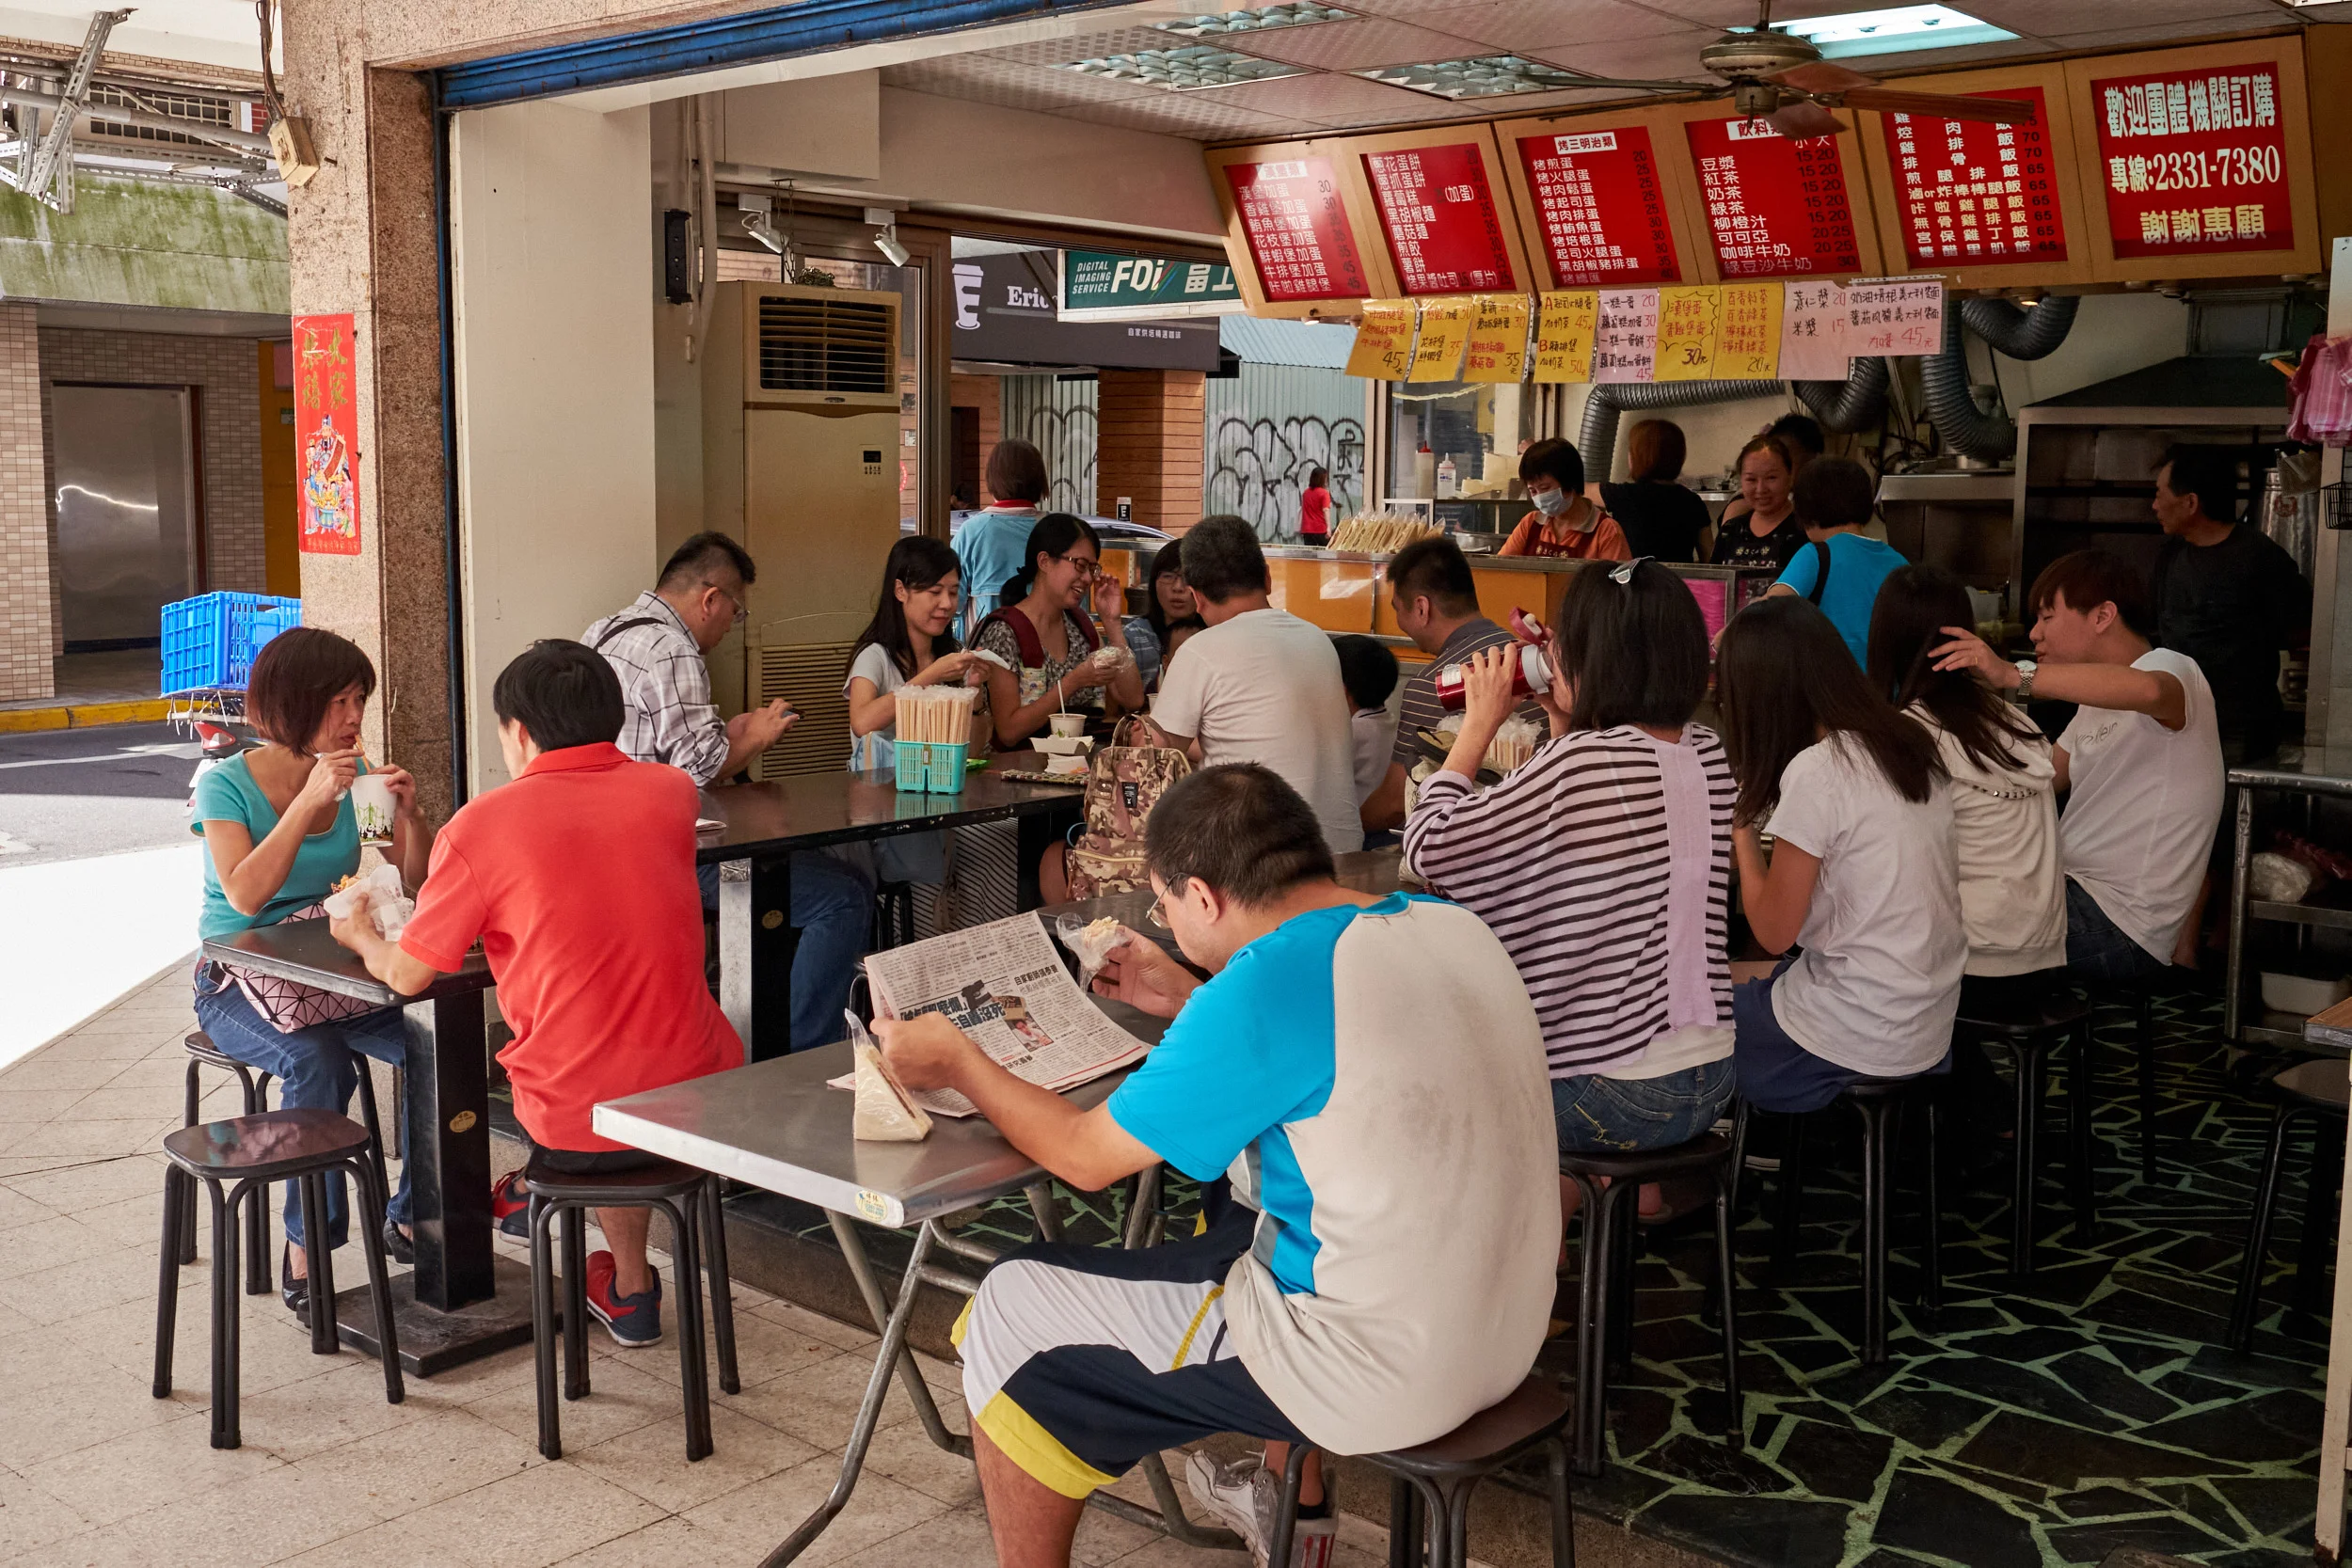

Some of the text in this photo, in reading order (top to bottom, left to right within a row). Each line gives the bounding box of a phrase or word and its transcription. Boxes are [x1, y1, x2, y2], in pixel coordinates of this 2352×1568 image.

[2105, 72, 2275, 137] 歡迎團體機關訂購
[1558, 135, 1614, 150] 烤三明治類
[2023, 132, 2040, 142] 70
[1700, 148, 1836, 172] 豆漿 15 20
[2025, 148, 2042, 158] 70
[1533, 156, 1575, 171] 烤煎蛋
[2026, 163, 2045, 174] 65
[2108, 145, 2280, 194] 專線:2331-7380
[1535, 168, 1591, 183] 烤火腿蛋
[1703, 163, 1838, 186] 紅茶 15 20
[1238, 180, 1331, 200] 漢堡加蛋 30
[1707, 179, 1841, 201] 奶茶 15 20
[2029, 180, 2047, 190] 65
[1244, 197, 1336, 216] 香雞堡加蛋 30
[1542, 196, 1597, 210] 烤起司蛋
[1709, 195, 1845, 216] 綠茶 15 20
[2032, 195, 2050, 206] 65
[1545, 208, 1600, 223] 烤肉排蛋
[1713, 210, 1848, 230] 柳橙汁 15 20
[1914, 211, 2053, 230] 無骨雞排飯 65
[1248, 215, 1313, 233] 鮪魚堡加蛋
[1549, 221, 1603, 235] 烤鮪魚蛋
[2140, 204, 2266, 244] 謝謝惠顧
[1253, 230, 1318, 248] 花枝堡加蛋
[1551, 233, 1606, 247] 烤培根蛋
[1716, 226, 1851, 245] 可可亞 20 25
[1916, 226, 2055, 244] 宮保雞丁飯 65
[1396, 241, 1422, 257] 煎餃
[1555, 245, 1623, 261] 起司火腿蛋
[1720, 240, 1853, 260] 咖啡牛奶 20 25
[2039, 240, 2058, 251] 65
[1258, 246, 1323, 263] 鮮蝦堡加蛋
[1076, 261, 1108, 273] DIGITAL
[1263, 262, 1327, 278] 牛排堡加蛋
[1401, 257, 1426, 274] 薯餅
[1724, 255, 1856, 275] 綠豆沙牛奶 30
[1074, 272, 1112, 283] IMAGING
[1073, 283, 1109, 294] SERVICE
[1545, 296, 1553, 310] A
[1642, 293, 1656, 308] 20
[1833, 292, 1846, 307] 20
[1644, 314, 1656, 327] 30
[1832, 318, 1845, 333] 15
[1539, 340, 1548, 352] B
[1645, 335, 1657, 349] 35
